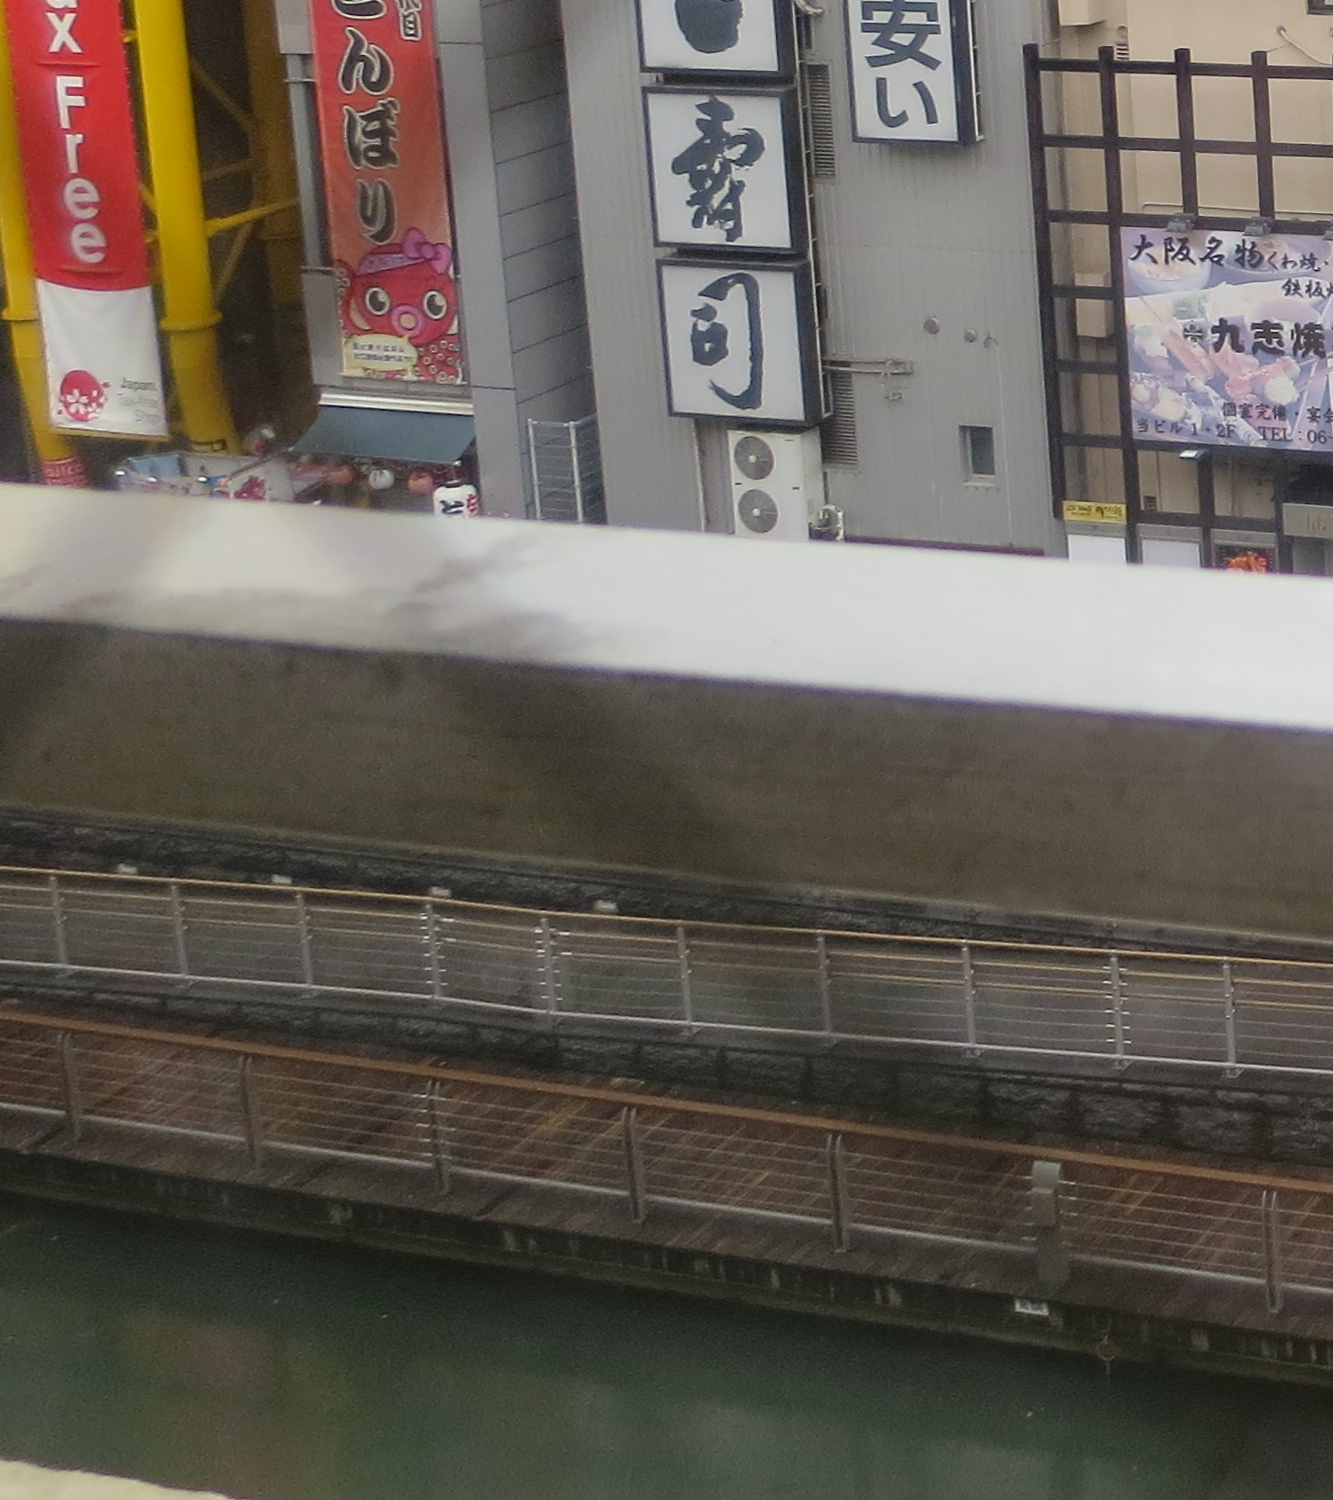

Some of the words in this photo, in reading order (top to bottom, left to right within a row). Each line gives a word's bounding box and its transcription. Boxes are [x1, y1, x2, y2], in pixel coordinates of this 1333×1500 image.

[55, 75, 107, 266] Free
[1129, 233, 1266, 270] 大阪名物
